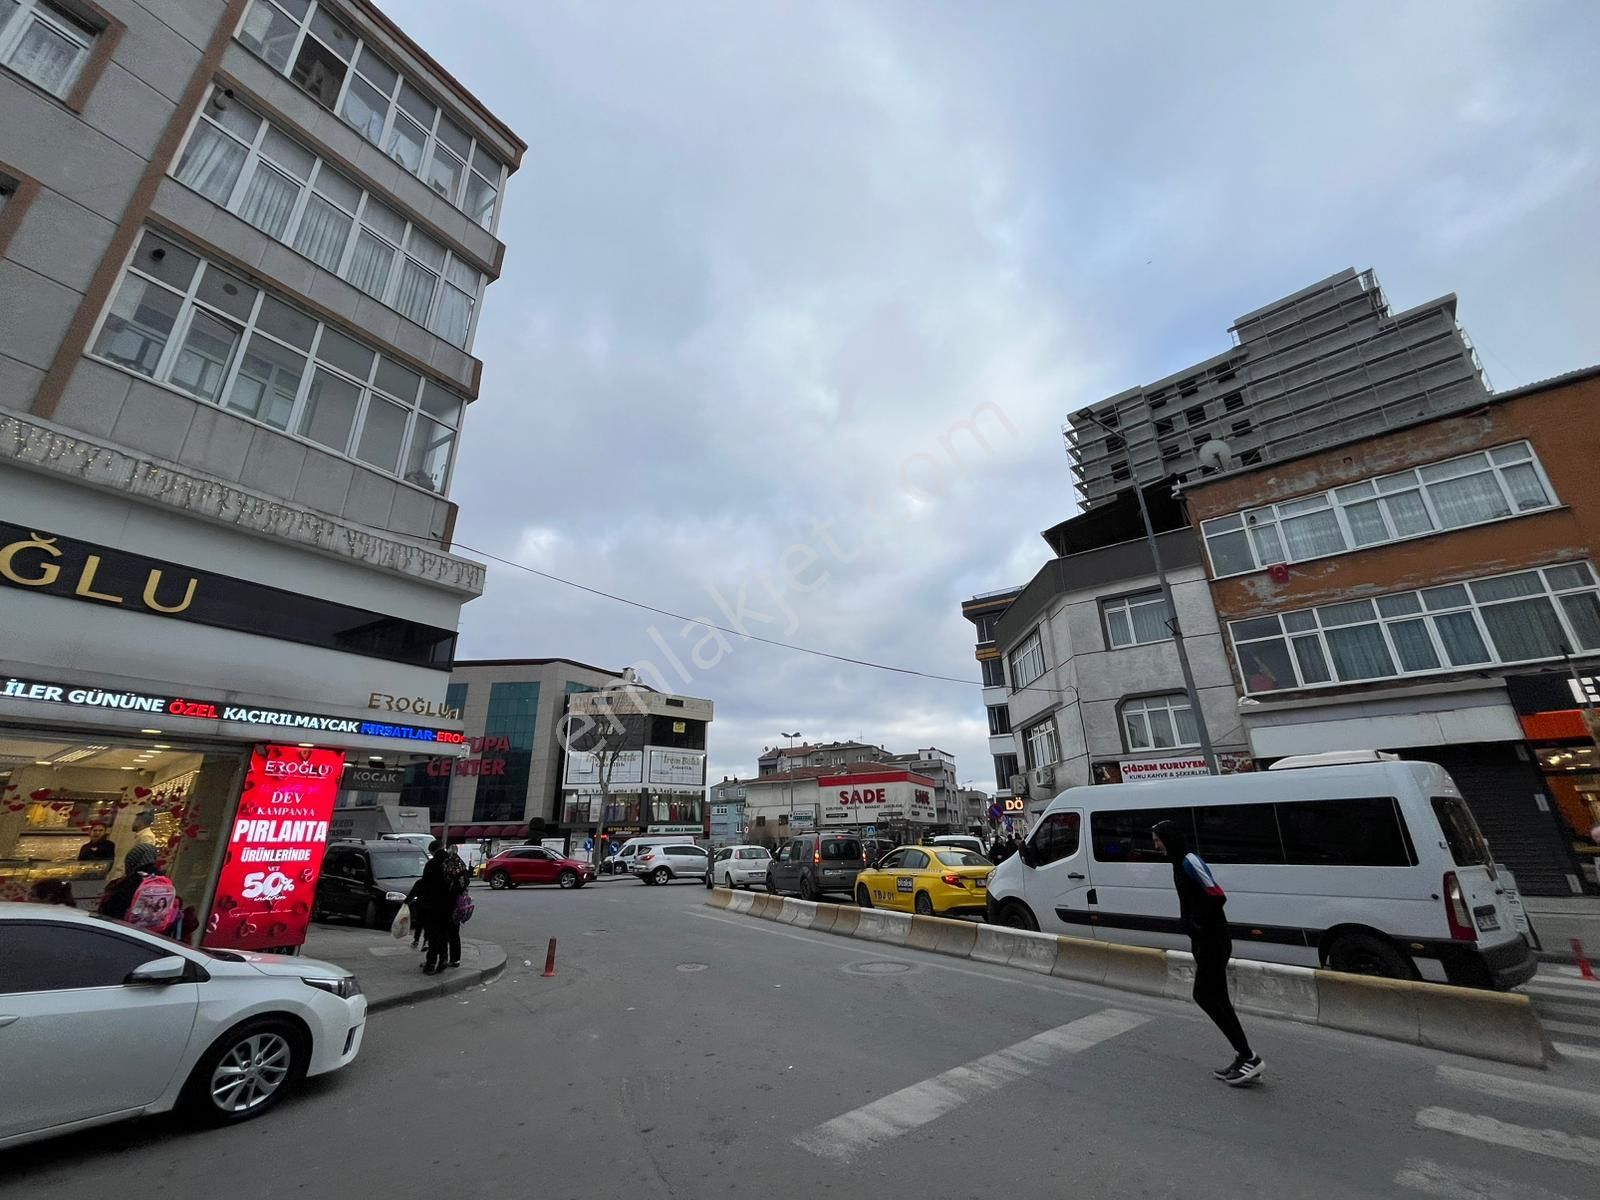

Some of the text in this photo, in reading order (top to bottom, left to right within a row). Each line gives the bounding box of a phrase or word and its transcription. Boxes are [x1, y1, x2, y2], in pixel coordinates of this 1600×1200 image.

[0, 532, 199, 613] ĞLU
[0, 679, 62, 701] İLER
[68, 689, 165, 713] GÜNÜNE
[169, 699, 218, 719] ÖZEL
[223, 707, 360, 732] KAÇIRILMAYCAK
[367, 692, 451, 718] EROĞLU
[464, 735, 511, 753] UPA
[265, 760, 330, 776] EROĞLU
[426, 758, 507, 776] CENTER
[1122, 759, 1207, 776] ÇİĞDEM KURUYEM
[1129, 773, 1146, 781] KURU
[1175, 769, 1209, 779] ŞEKERLEM
[271, 791, 304, 804] DEV
[839, 788, 886, 805] SADE
[1005, 796, 1024, 810] DÖ
[256, 806, 315, 817] KAMPANYA
[232, 819, 328, 843] PIRLANTA
[241, 847, 312, 863] ÜRÜNLERİNDE
[241, 871, 295, 899] 50%
